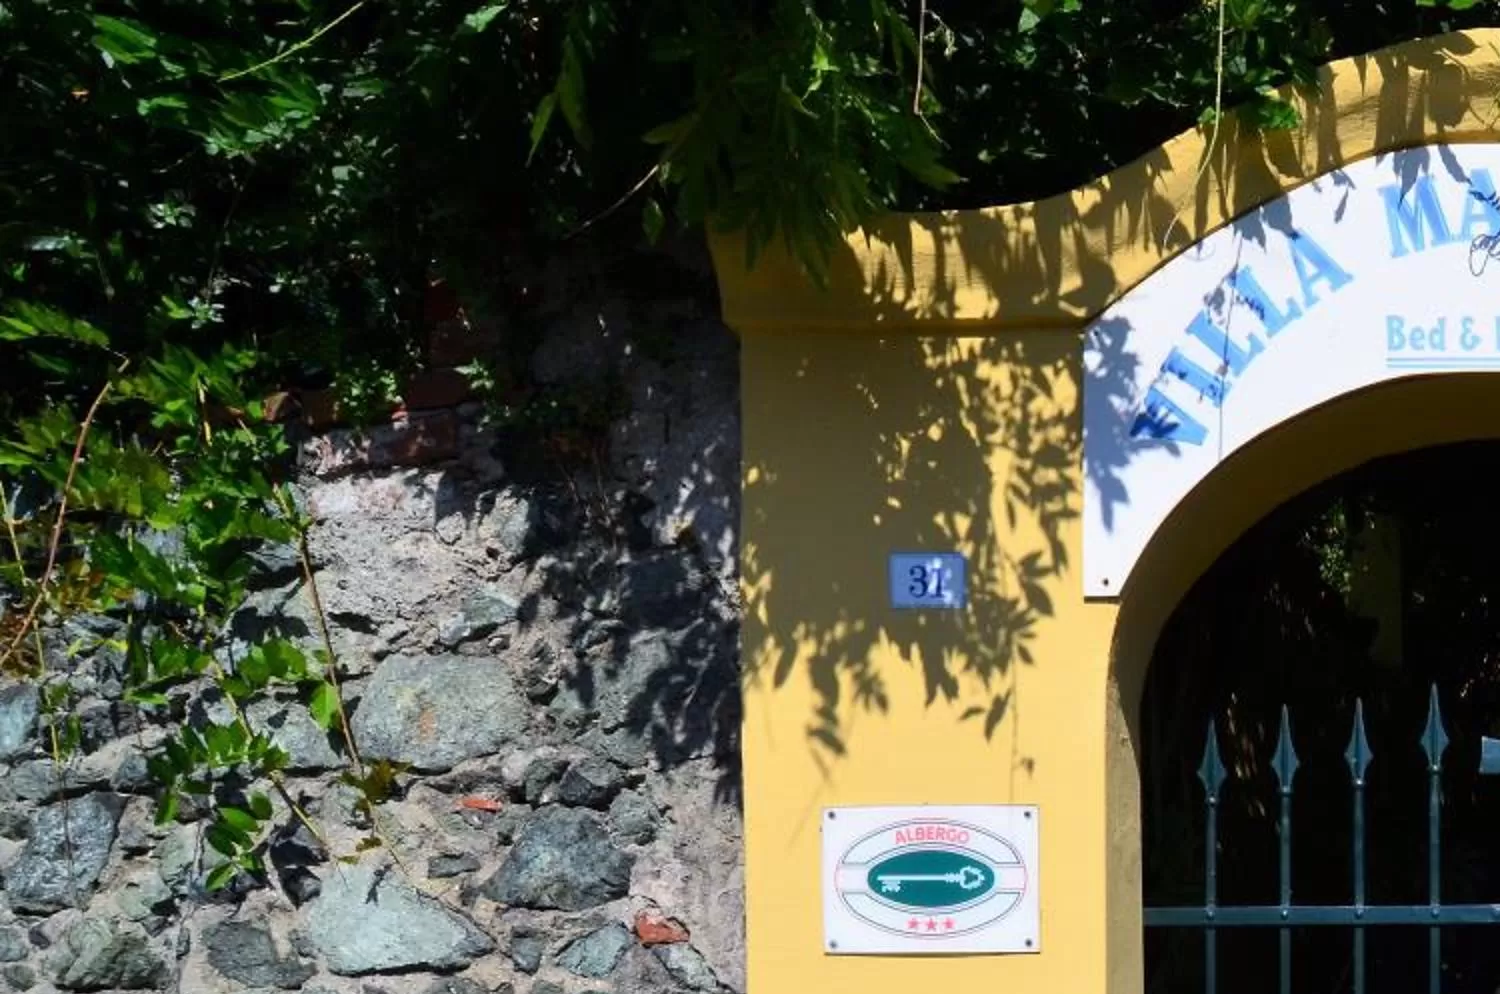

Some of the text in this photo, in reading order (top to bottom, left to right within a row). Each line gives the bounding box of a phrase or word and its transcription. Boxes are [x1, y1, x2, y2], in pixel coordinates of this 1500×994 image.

[1130, 228, 1354, 446] VILLA
[1385, 315, 1447, 352] Bed
[1460, 315, 1483, 352] &
[908, 564, 946, 598] 31
[895, 826, 970, 845] ALBERGO
